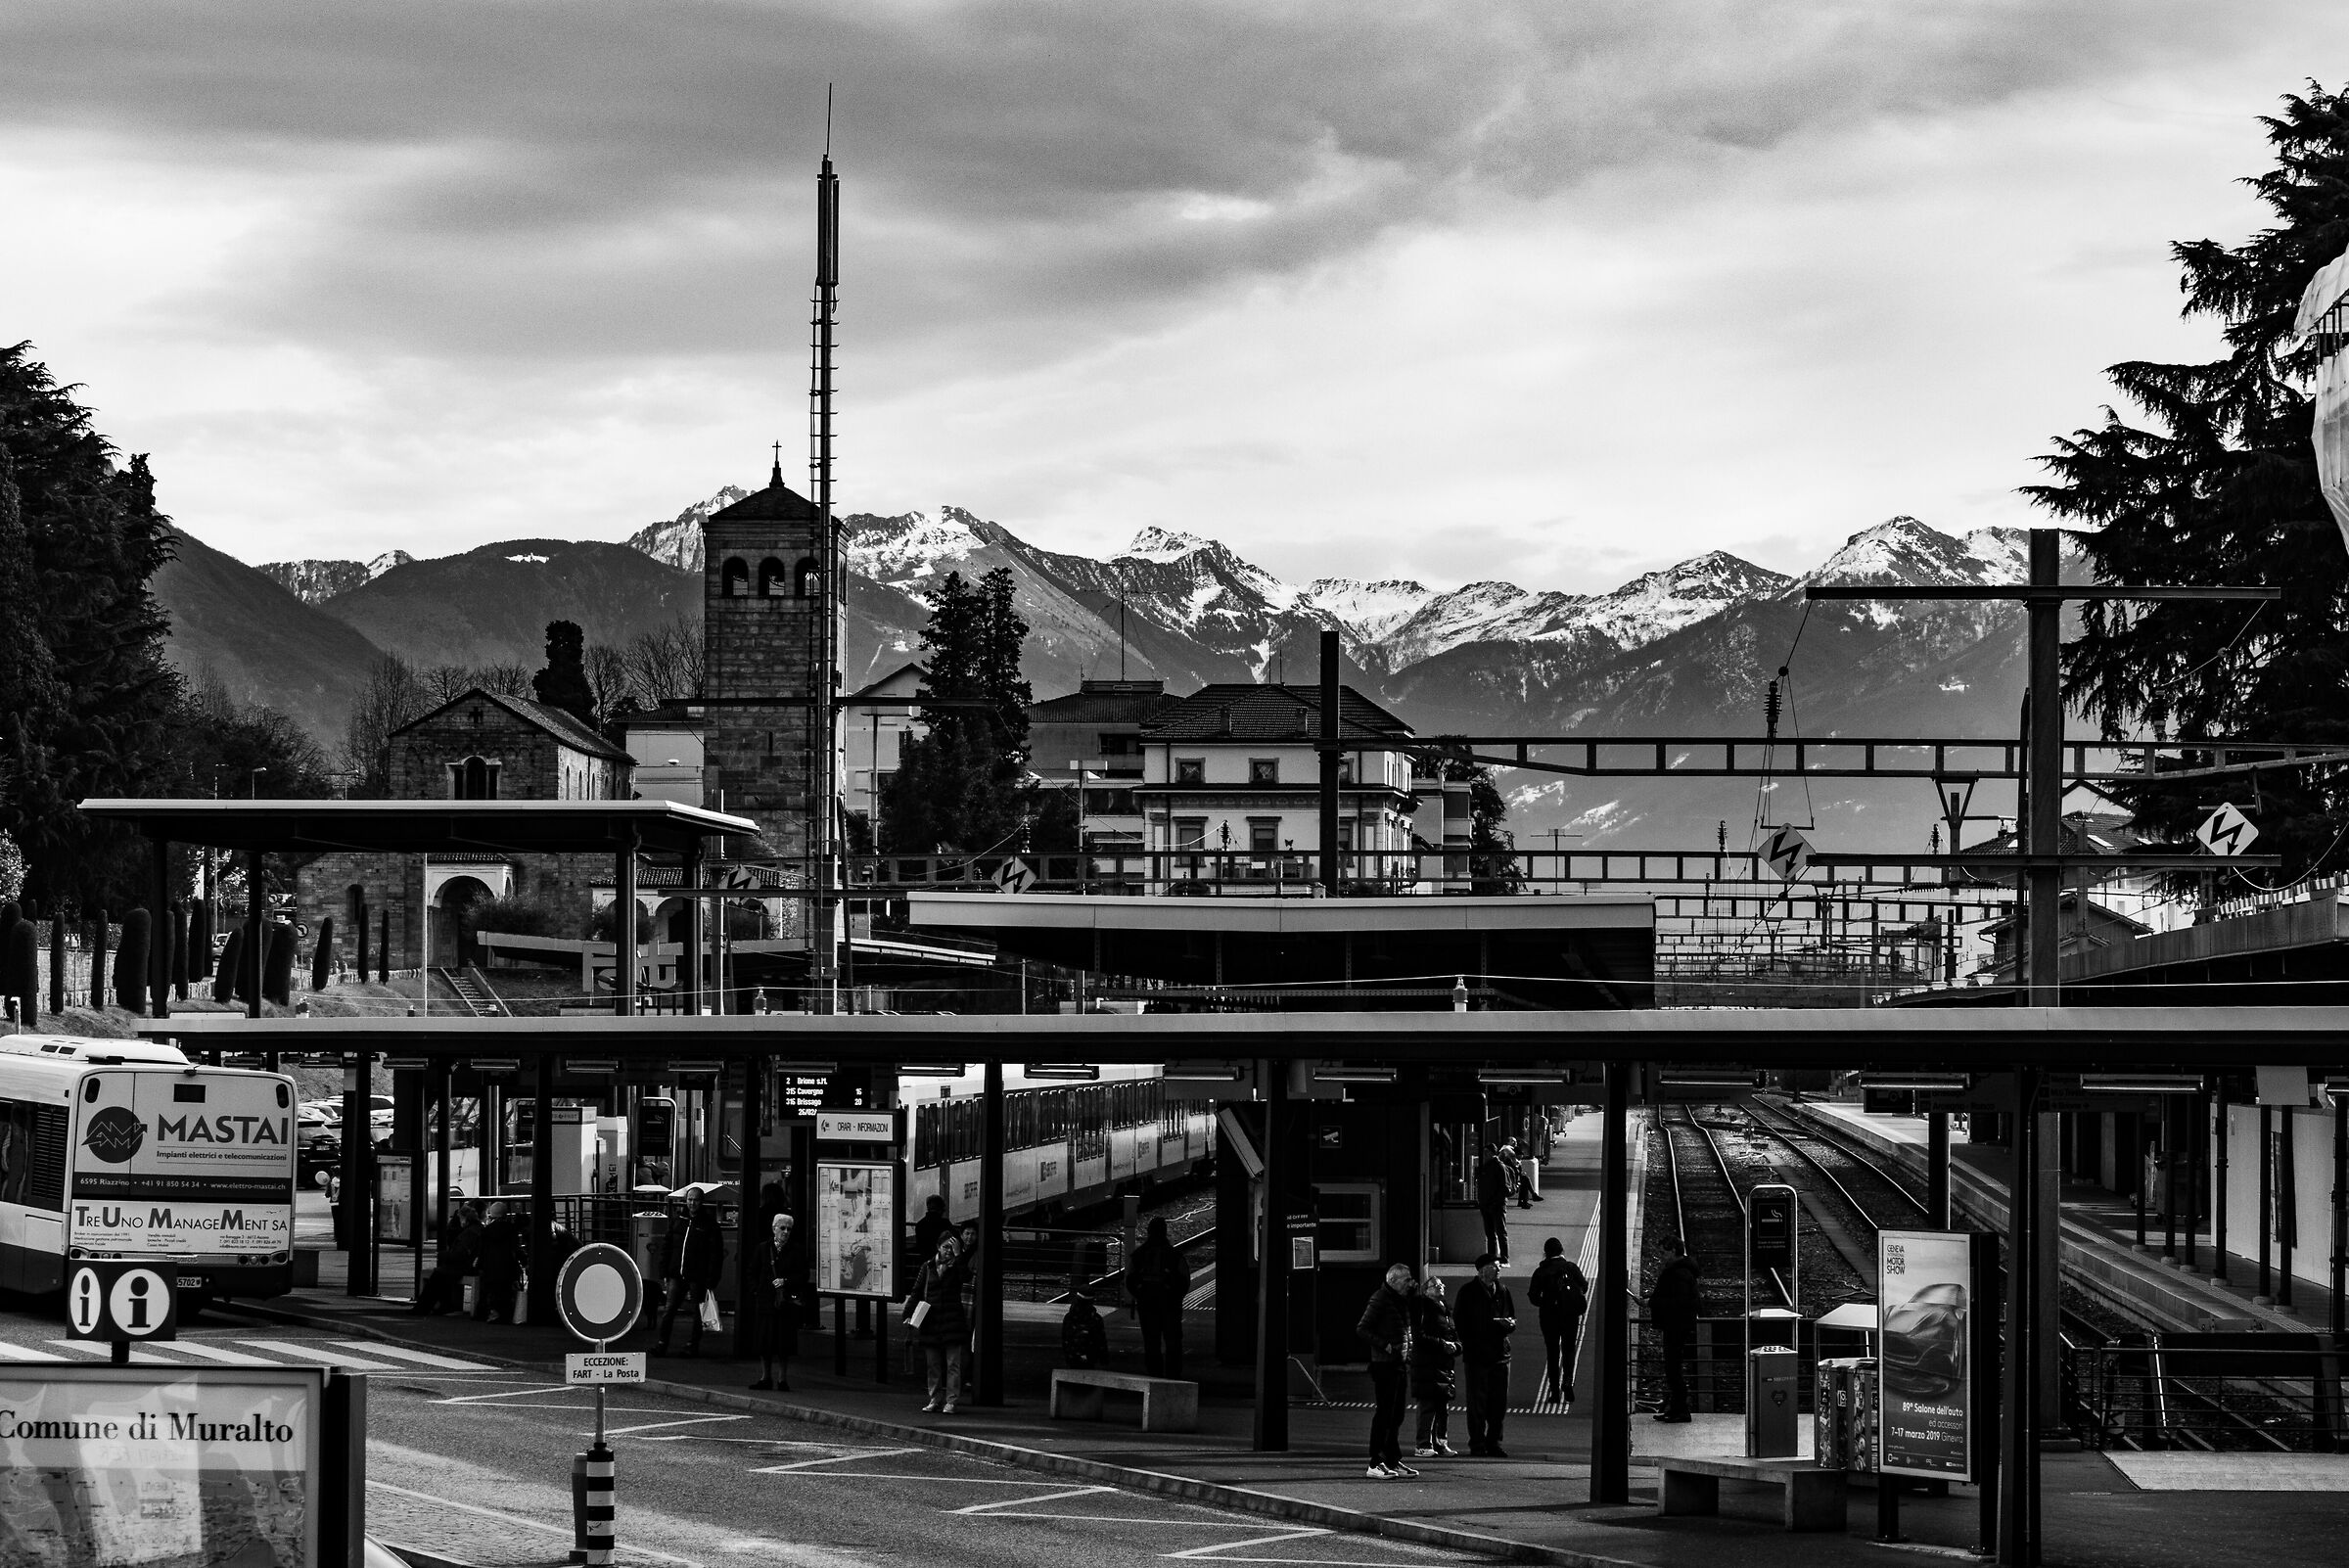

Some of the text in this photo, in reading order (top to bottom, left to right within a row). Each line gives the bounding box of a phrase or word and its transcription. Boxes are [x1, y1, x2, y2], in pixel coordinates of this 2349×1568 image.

[158, 1114, 288, 1144] MASTAI
[838, 1122, 852, 1131] ORARI
[857, 1122, 888, 1132] INFORMAZIONI
[157, 1151, 187, 1160] Impianti
[224, 1152, 287, 1161] telecomunicazioni
[272, 1220, 287, 1230] SA
[1887, 1265, 1905, 1274] SHOW
[584, 1357, 628, 1366] ECCEZIONE:
[604, 1369, 613, 1378] La
[1914, 1403, 1935, 1413] Salone
[1937, 1405, 1963, 1416] dell'auto
[0, 1409, 294, 1443] Comune di Muralto
[1938, 1420, 1963, 1429] accessori
[1891, 1427, 1963, 1443] 7-17 marzo 2019 Ginevra
